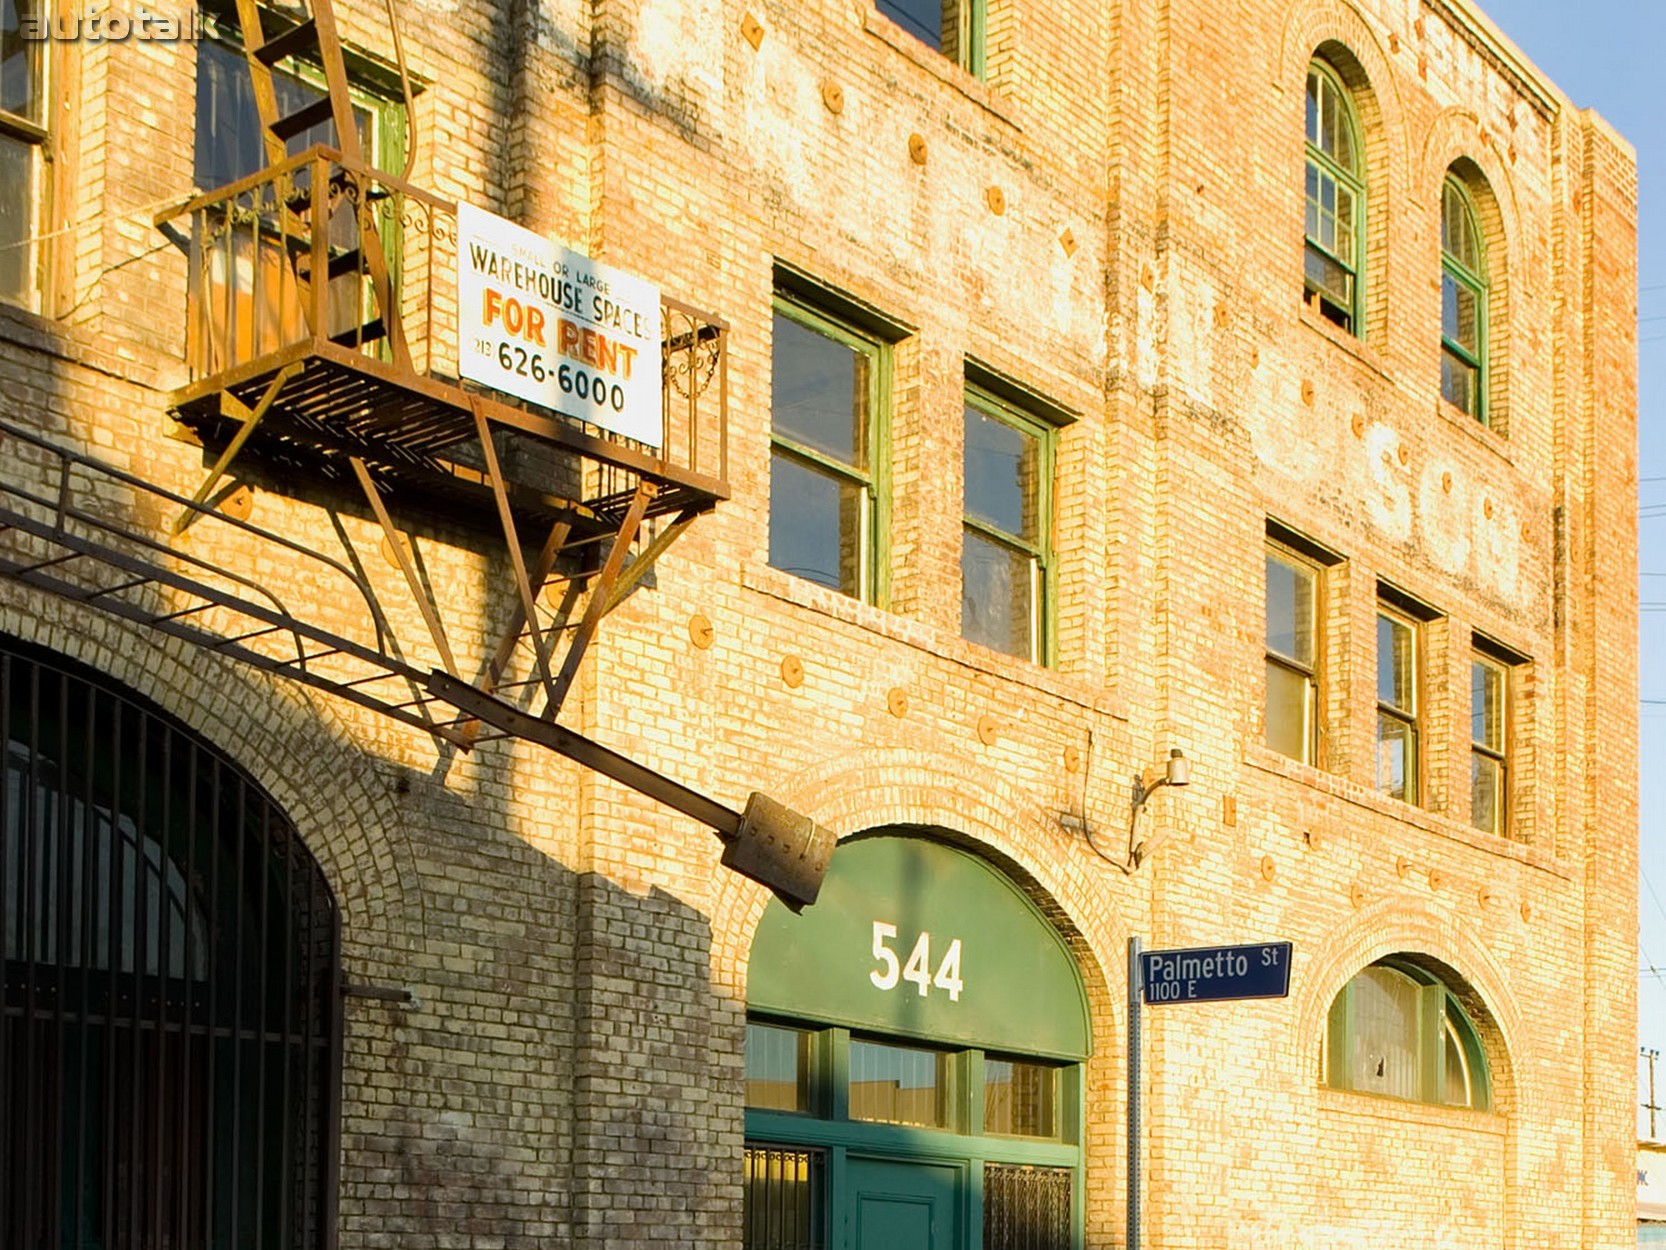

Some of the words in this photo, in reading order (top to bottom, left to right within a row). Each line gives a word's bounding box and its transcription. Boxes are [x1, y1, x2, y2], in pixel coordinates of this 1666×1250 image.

[469, 242, 583, 314] WAREHOUSE
[593, 295, 651, 341] SPACES
[553, 261, 569, 278] OR
[577, 272, 610, 295] LARGE
[482, 287, 546, 348] FOR
[557, 317, 638, 381] RENT
[498, 342, 625, 413] 626-6000
[869, 920, 963, 1002] 544
[1150, 951, 1248, 982] Palmetto
[1261, 947, 1279, 966] St
[1150, 981, 1180, 1000] 1100
[1188, 980, 1197, 998] E
